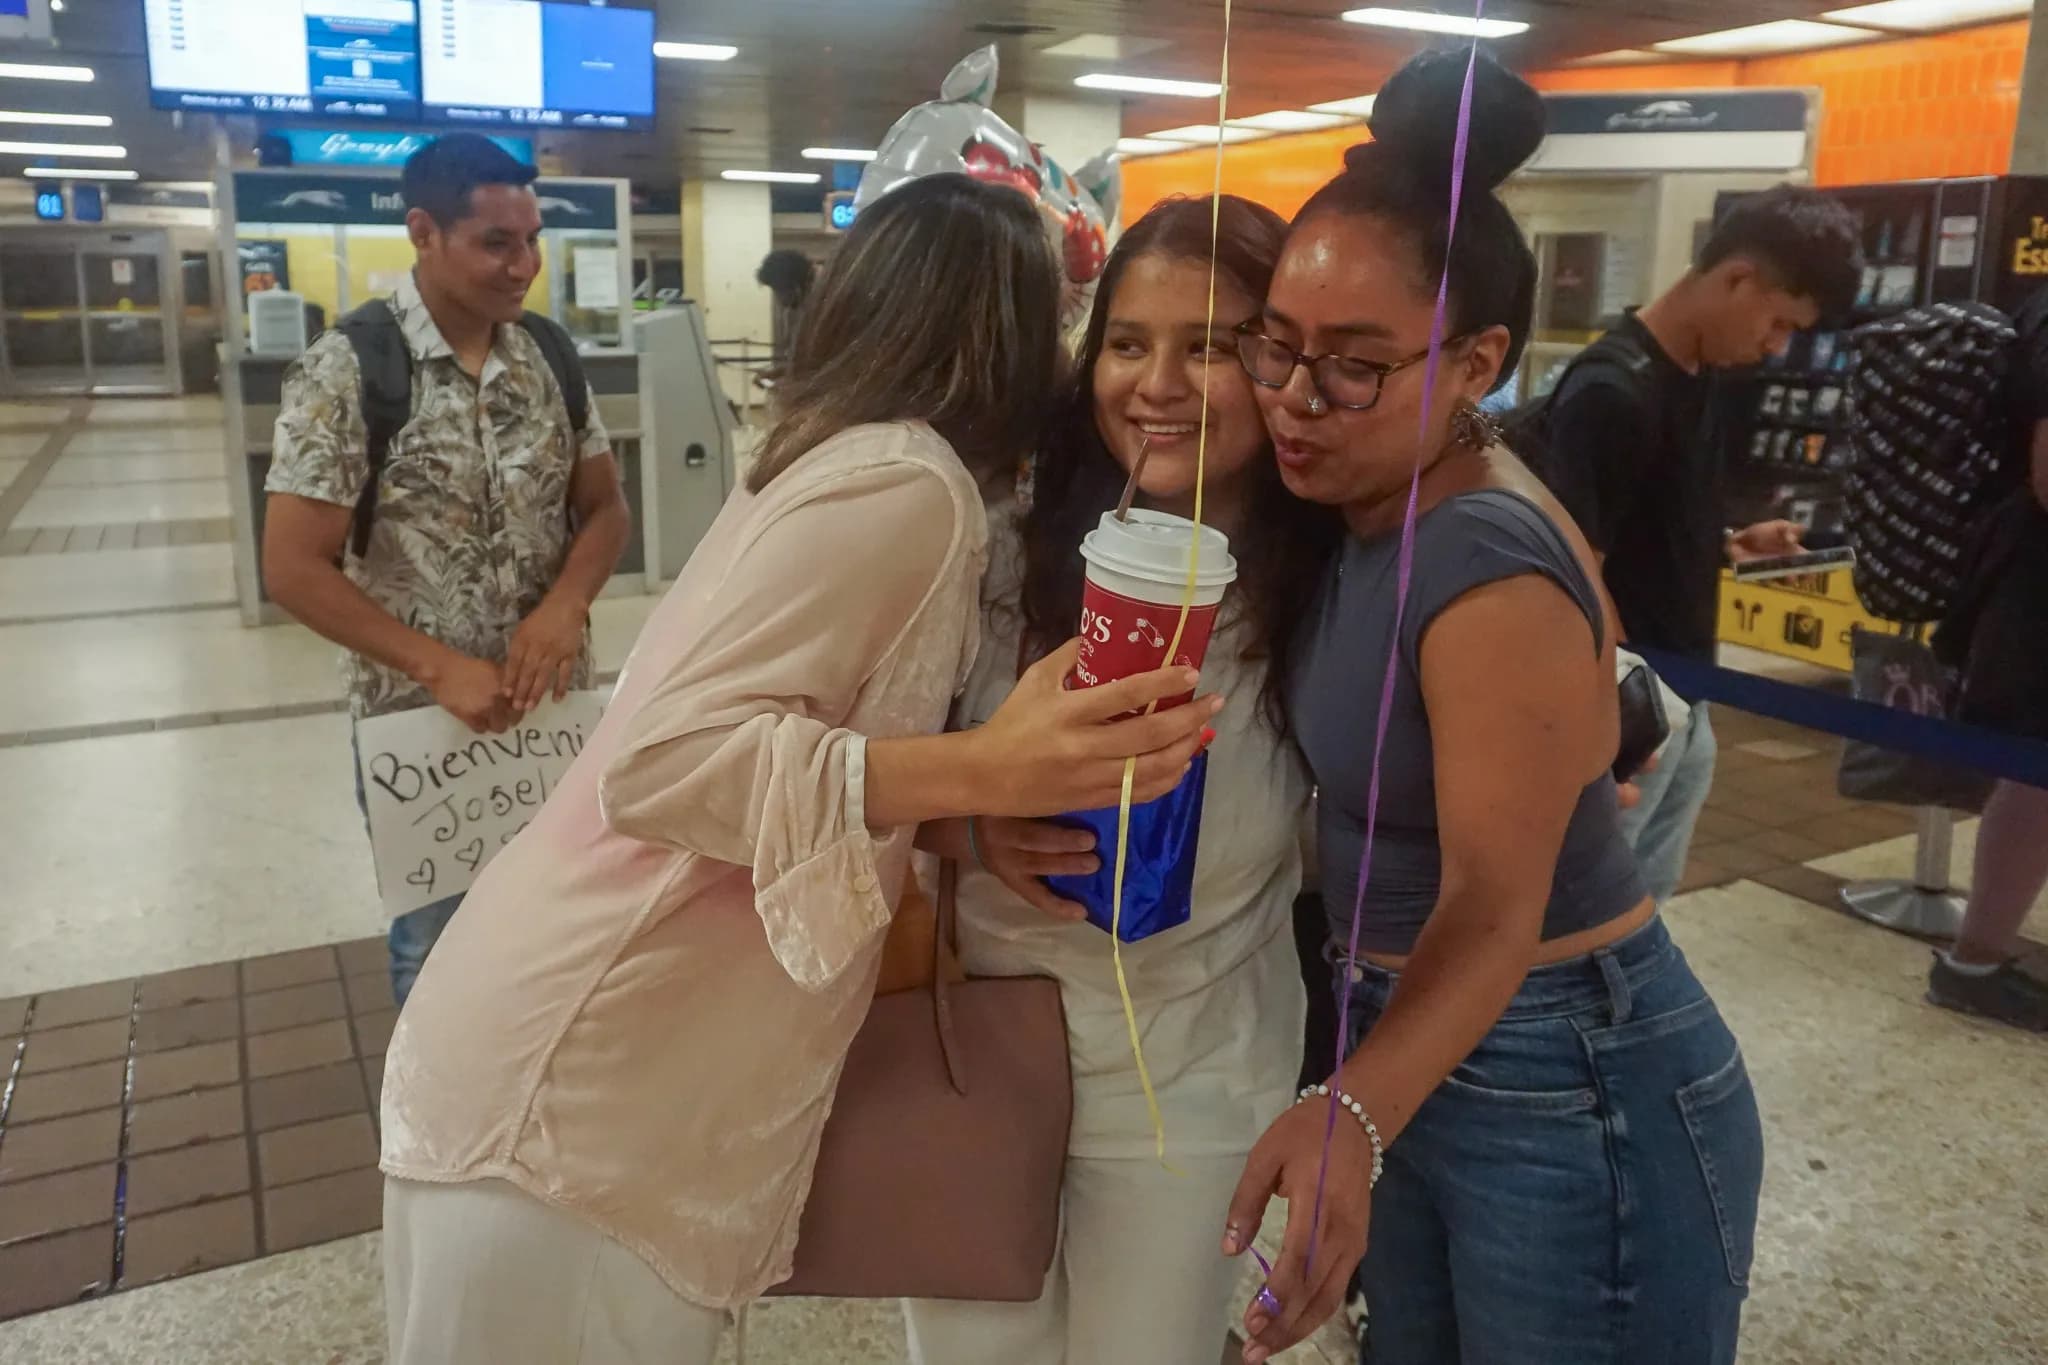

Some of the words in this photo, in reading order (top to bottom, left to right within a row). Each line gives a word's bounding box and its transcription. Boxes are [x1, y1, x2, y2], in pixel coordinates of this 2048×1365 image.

[320, 132, 419, 159] Greyh
[371, 191, 405, 210] Inf
[1081, 607, 1112, 643] O'S
[369, 723, 585, 803] Bienveni
[411, 767, 558, 842] Josel
